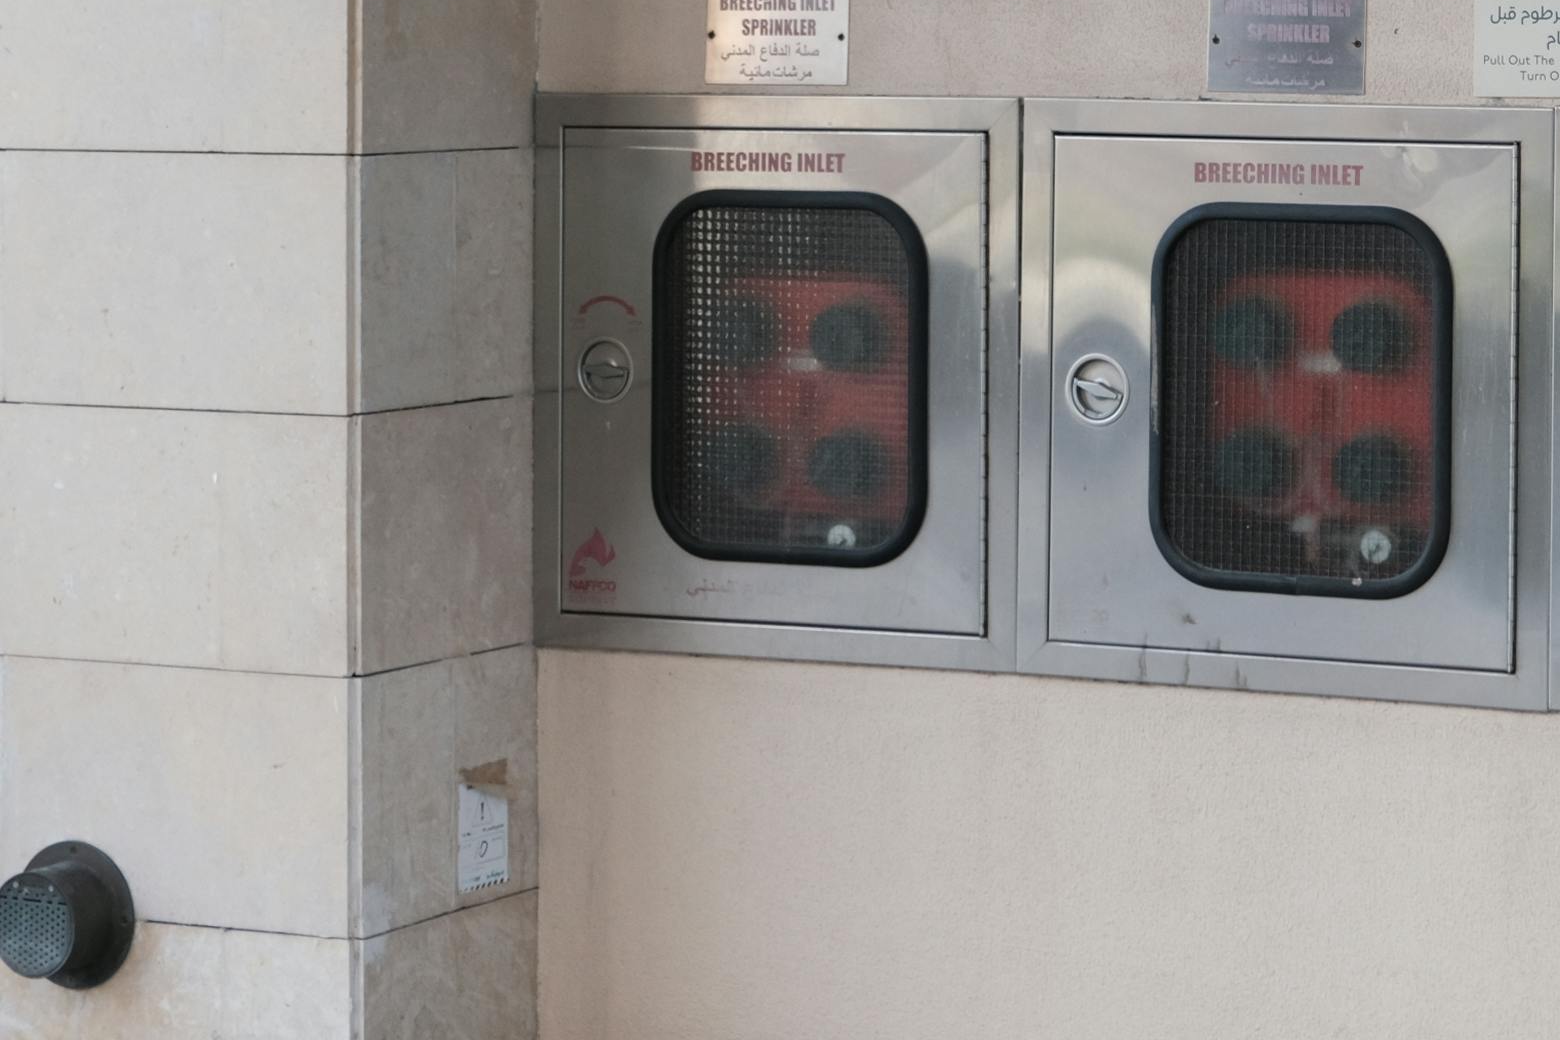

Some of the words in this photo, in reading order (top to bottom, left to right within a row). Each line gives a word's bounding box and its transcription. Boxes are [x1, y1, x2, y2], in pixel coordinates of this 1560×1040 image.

[1490, 6, 1517, 24] قبل
[742, 19, 816, 36] SPRINKLER
[1248, 23, 1330, 43] SPRINKLER
[721, 44, 755, 61] المدني
[759, 44, 791, 62] الدفاع
[1483, 55, 1505, 65] Pull
[1508, 55, 1530, 66] Out
[1533, 55, 1555, 65] The
[1520, 71, 1546, 81] Turn
[690, 151, 792, 172] BREECHING
[797, 153, 845, 173] INLET
[1194, 162, 1305, 185] BREECHING
[1310, 164, 1364, 186] INLET
